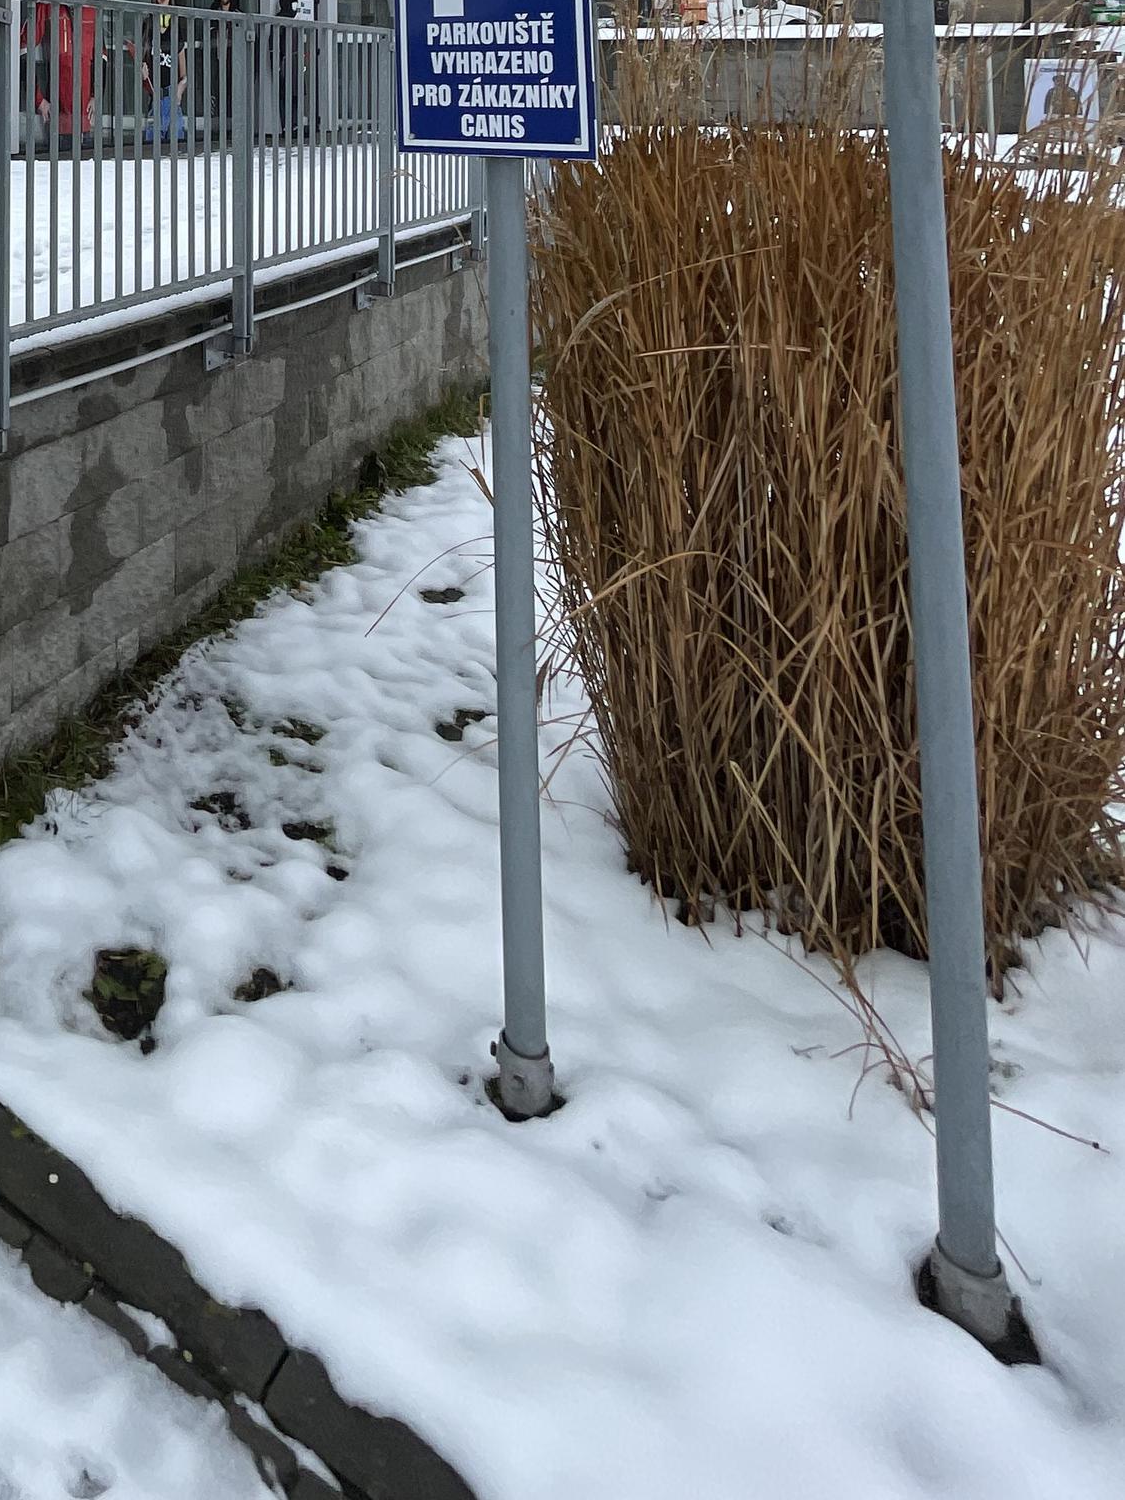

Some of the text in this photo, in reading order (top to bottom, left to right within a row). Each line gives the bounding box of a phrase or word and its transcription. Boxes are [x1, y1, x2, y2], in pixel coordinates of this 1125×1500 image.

[427, 12, 555, 45] PARKOVIŠTĚ
[431, 51, 553, 74] VYHRAZENO
[412, 77, 577, 108] PRO ZÁKAZNÍKY
[461, 114, 525, 138] CANIS
